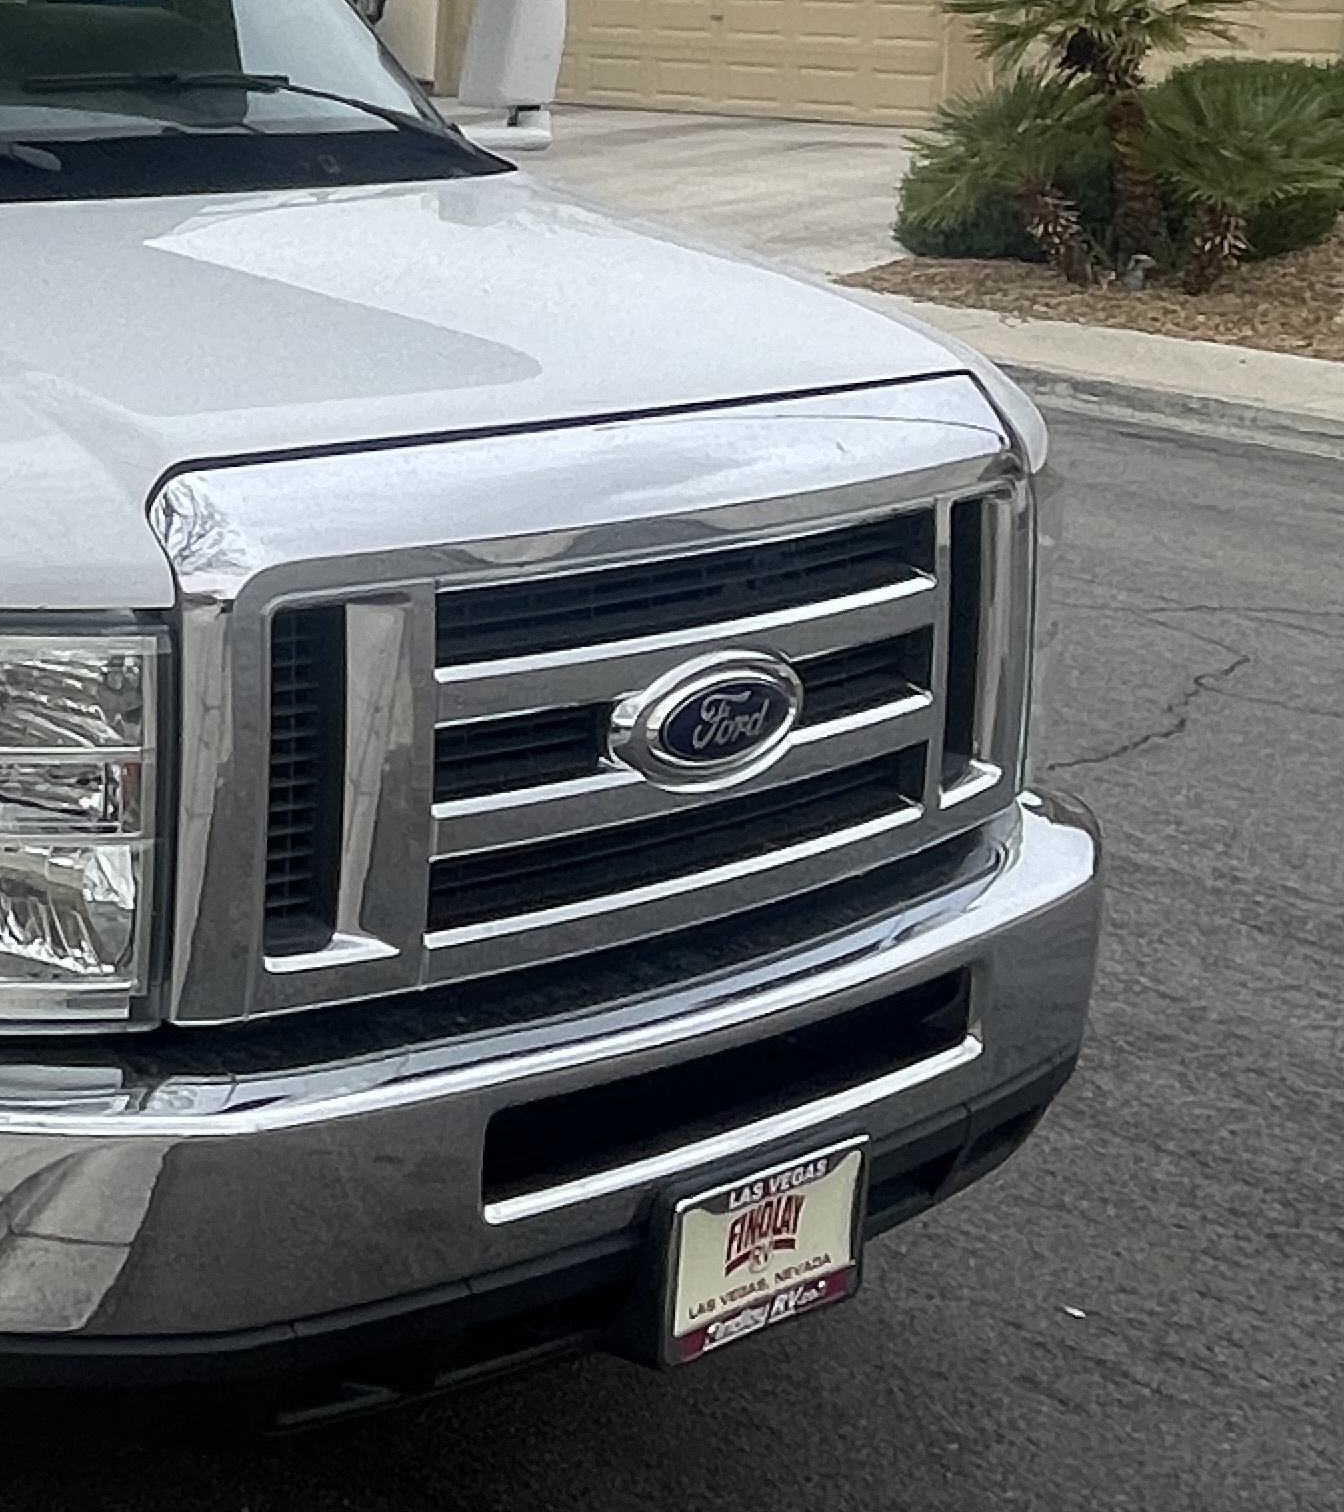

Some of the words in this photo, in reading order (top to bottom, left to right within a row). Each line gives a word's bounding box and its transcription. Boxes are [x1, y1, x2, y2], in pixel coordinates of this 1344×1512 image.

[692, 690, 770, 750] Ford
[729, 1182, 763, 1209] LAS
[768, 1159, 828, 1192] VEGAS
[726, 1194, 806, 1263] FINDLAY
[689, 1299, 716, 1320] LAS
[775, 1252, 832, 1283] NEVADA
